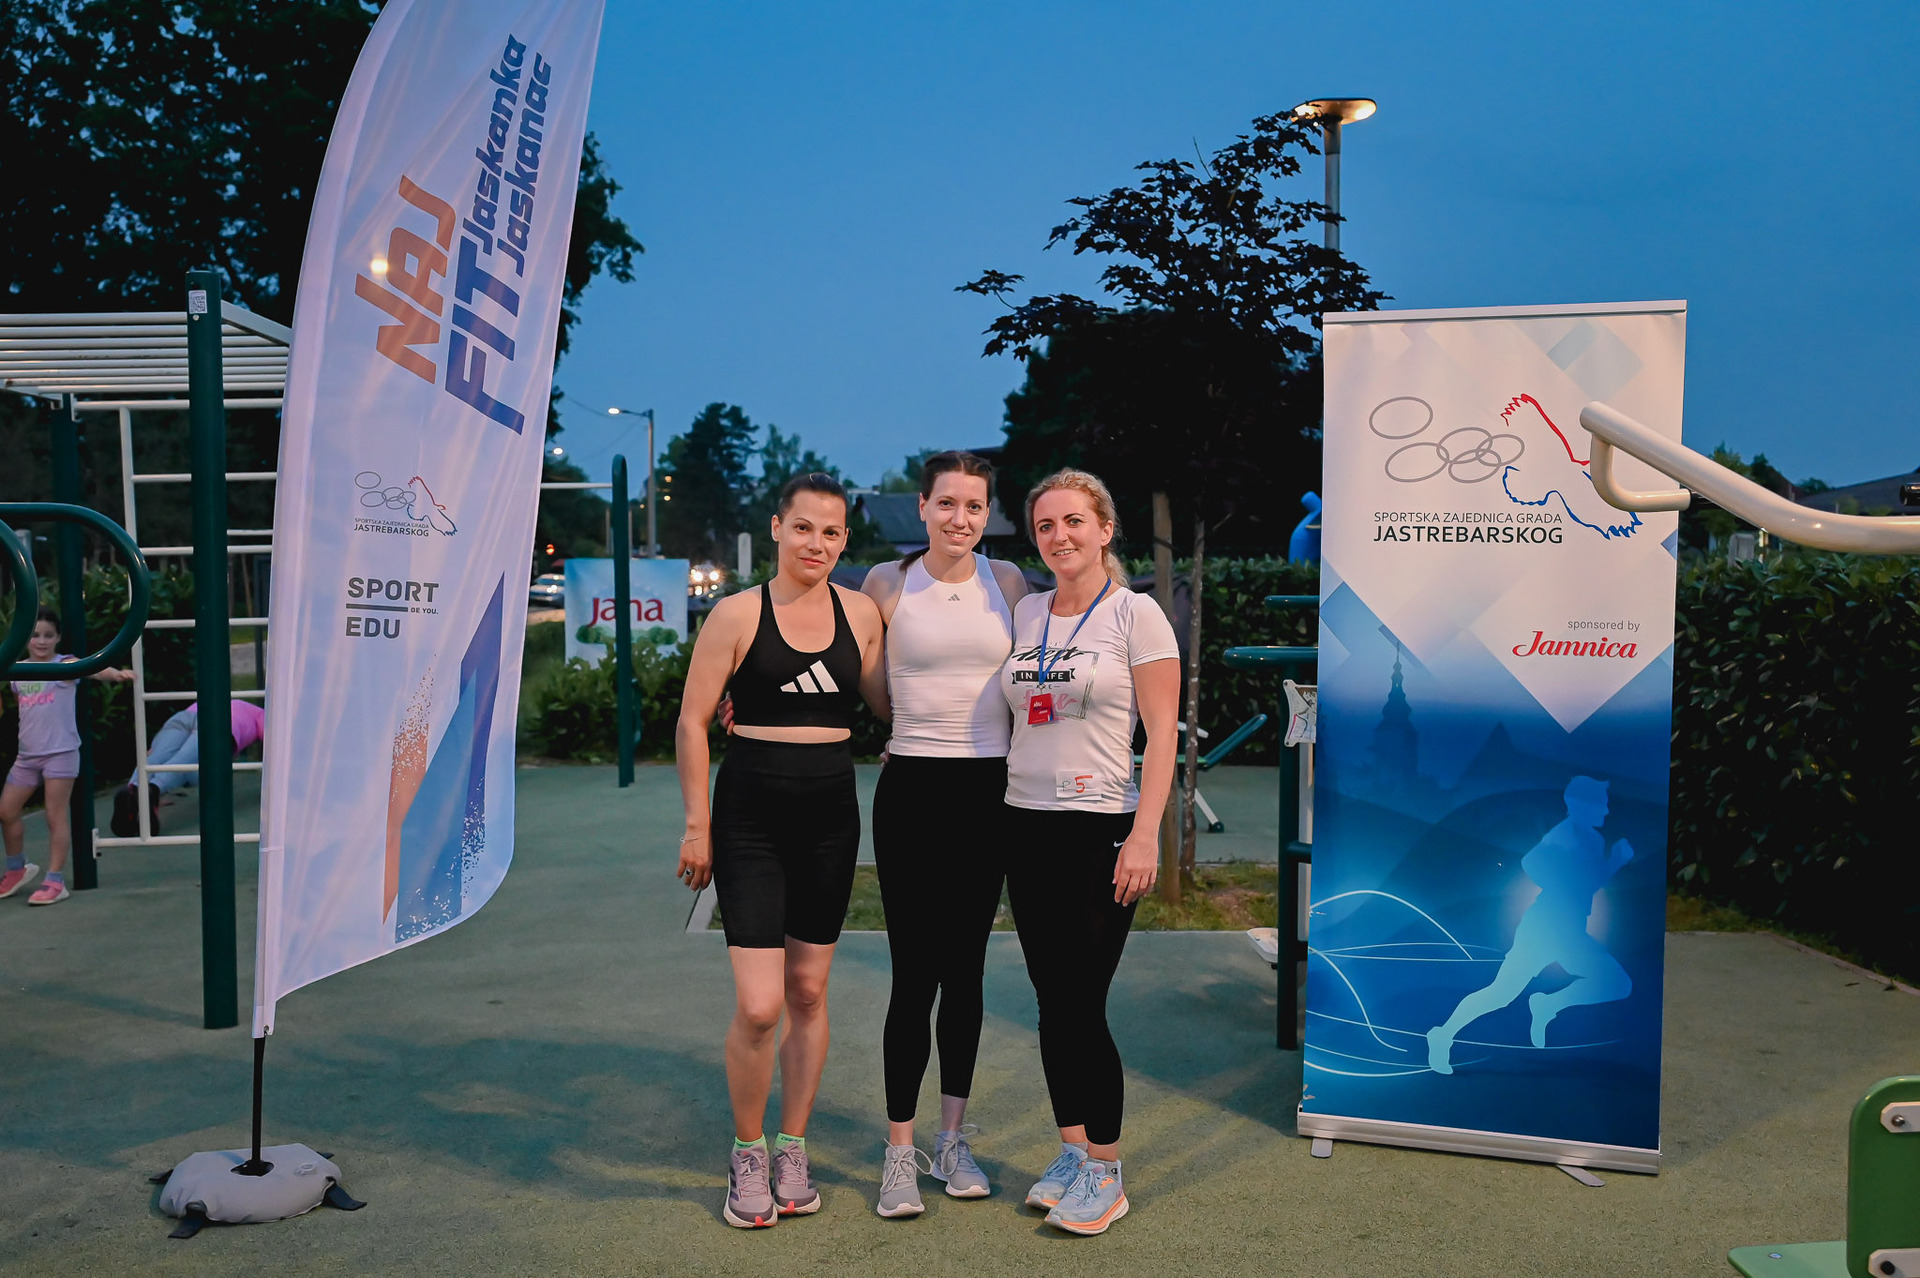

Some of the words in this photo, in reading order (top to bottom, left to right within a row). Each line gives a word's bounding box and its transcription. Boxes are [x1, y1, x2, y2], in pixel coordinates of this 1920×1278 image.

[462, 33, 527, 256] Jaskanka
[497, 52, 552, 278] Jaskanac
[355, 174, 456, 384] NAJ
[445, 235, 525, 435] FIT
[1374, 511, 1441, 523] SPORTSKA
[1443, 512, 1513, 523] ZAJEDNICA
[1516, 513, 1563, 524] GRADA
[353, 523, 430, 537] JASTREBARSKOG
[1373, 525, 1563, 544] JASTREBARSKOG
[347, 577, 439, 603] SPORT
[346, 616, 401, 639] EDU
[1567, 620, 1624, 631] sponsored
[1627, 620, 1641, 633] by
[1511, 630, 1638, 659] Jamnica
[1020, 672, 1033, 680] IN
[1045, 672, 1064, 680] IFE
[1074, 774, 1093, 793] 5
